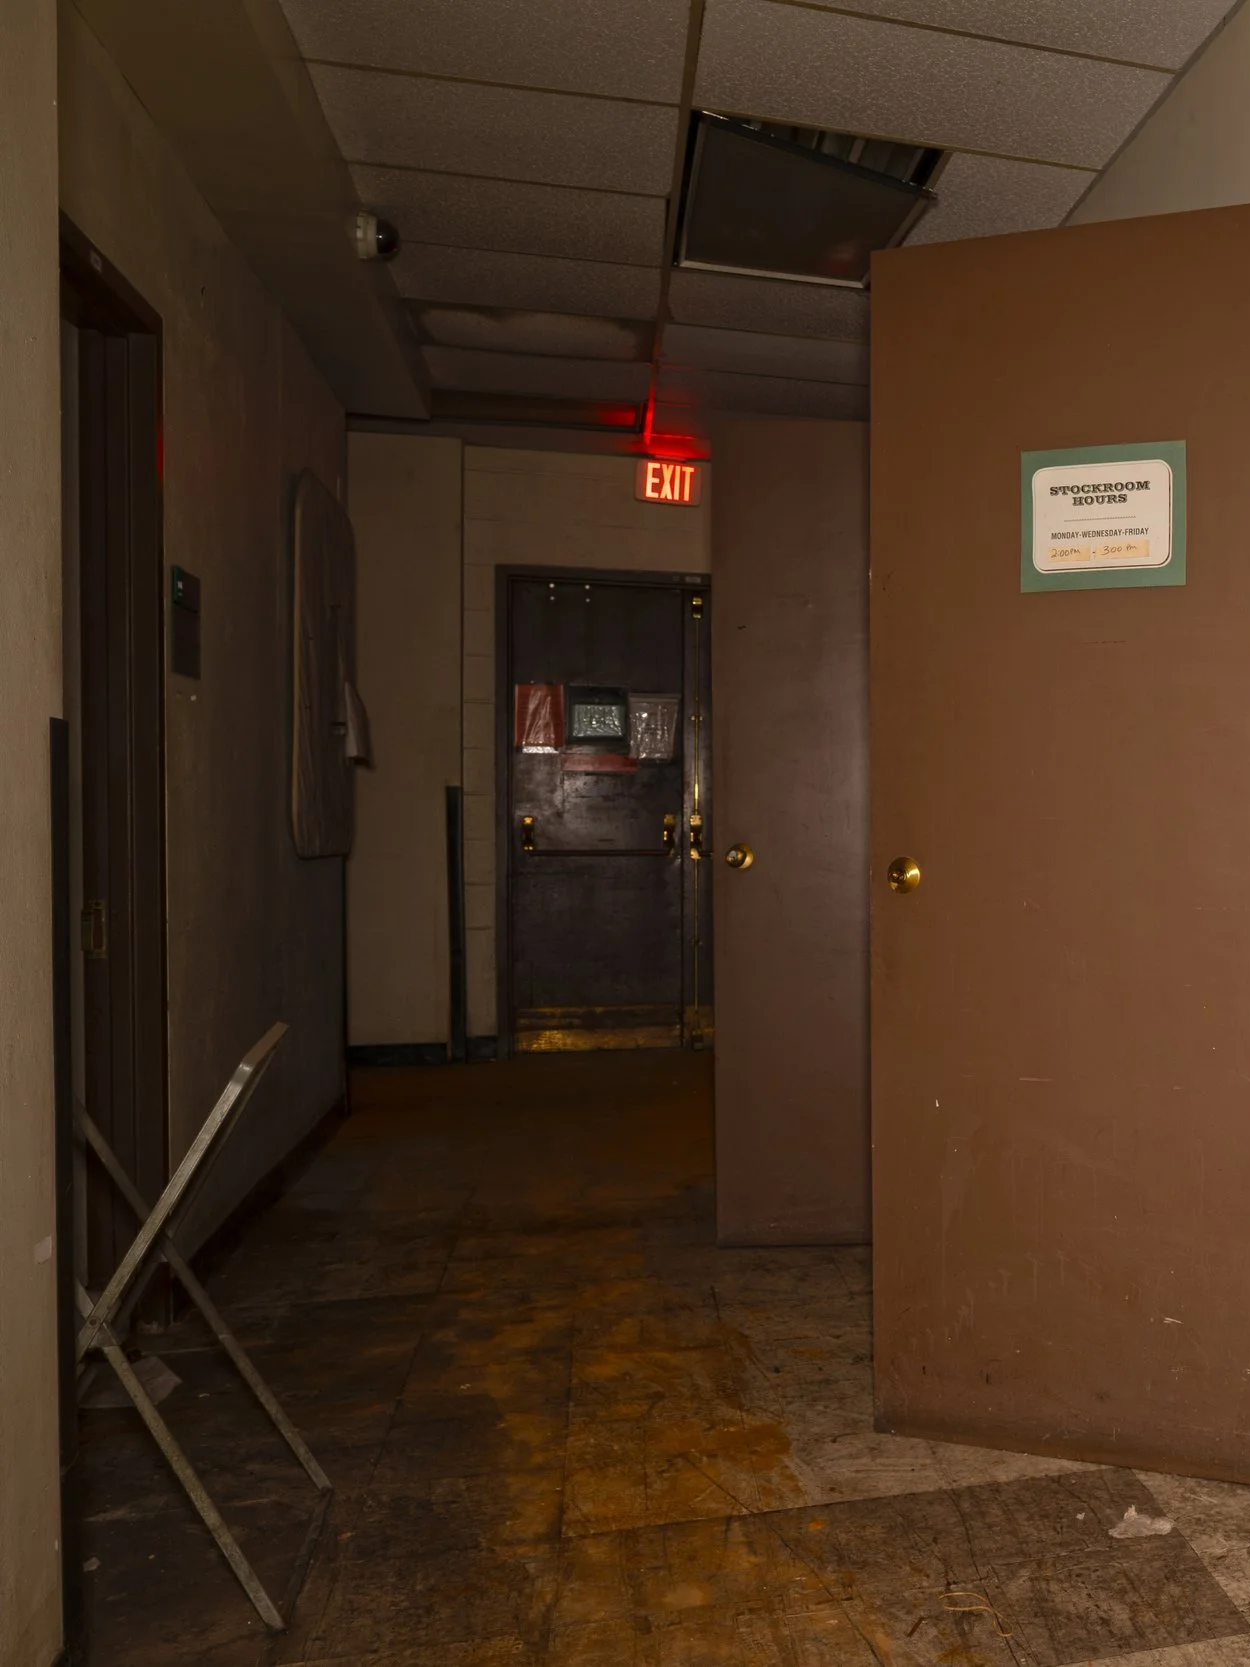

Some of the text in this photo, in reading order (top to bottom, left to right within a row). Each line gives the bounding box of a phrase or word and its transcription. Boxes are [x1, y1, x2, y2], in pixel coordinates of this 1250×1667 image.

[645, 462, 695, 502] EXIT
[1050, 480, 1151, 496] STOCKROOM
[1072, 493, 1128, 506] HOURS
[1051, 527, 1149, 540] MONDAY-WEDNESDAY-FRIDAY
